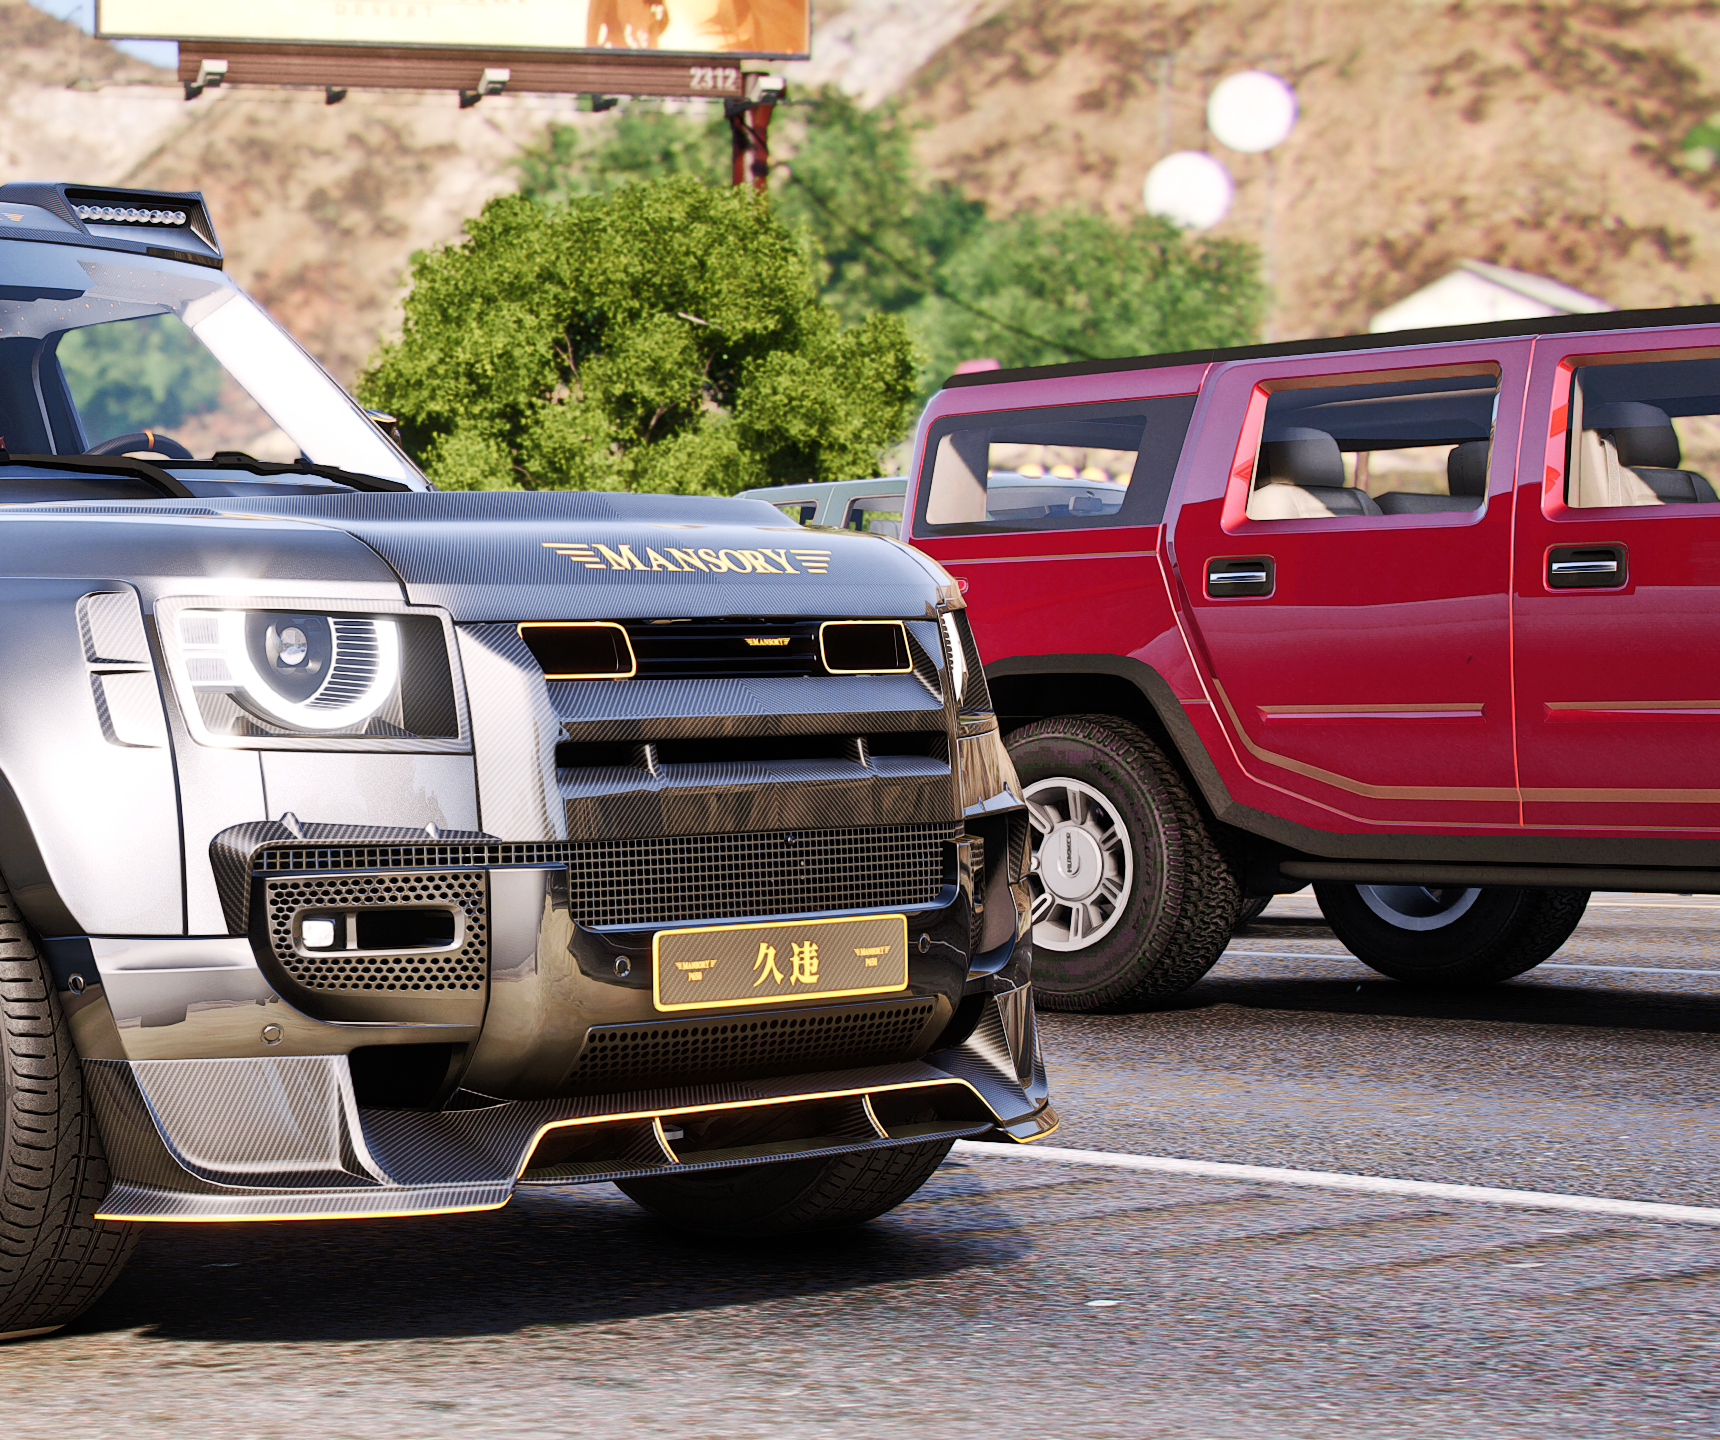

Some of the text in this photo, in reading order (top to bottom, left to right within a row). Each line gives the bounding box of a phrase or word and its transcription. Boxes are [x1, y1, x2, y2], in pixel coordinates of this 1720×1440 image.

[334, 3, 434, 18] DESERT
[689, 66, 738, 91] 2312
[591, 543, 801, 574] MANSORY
[753, 940, 820, 987] 久违
